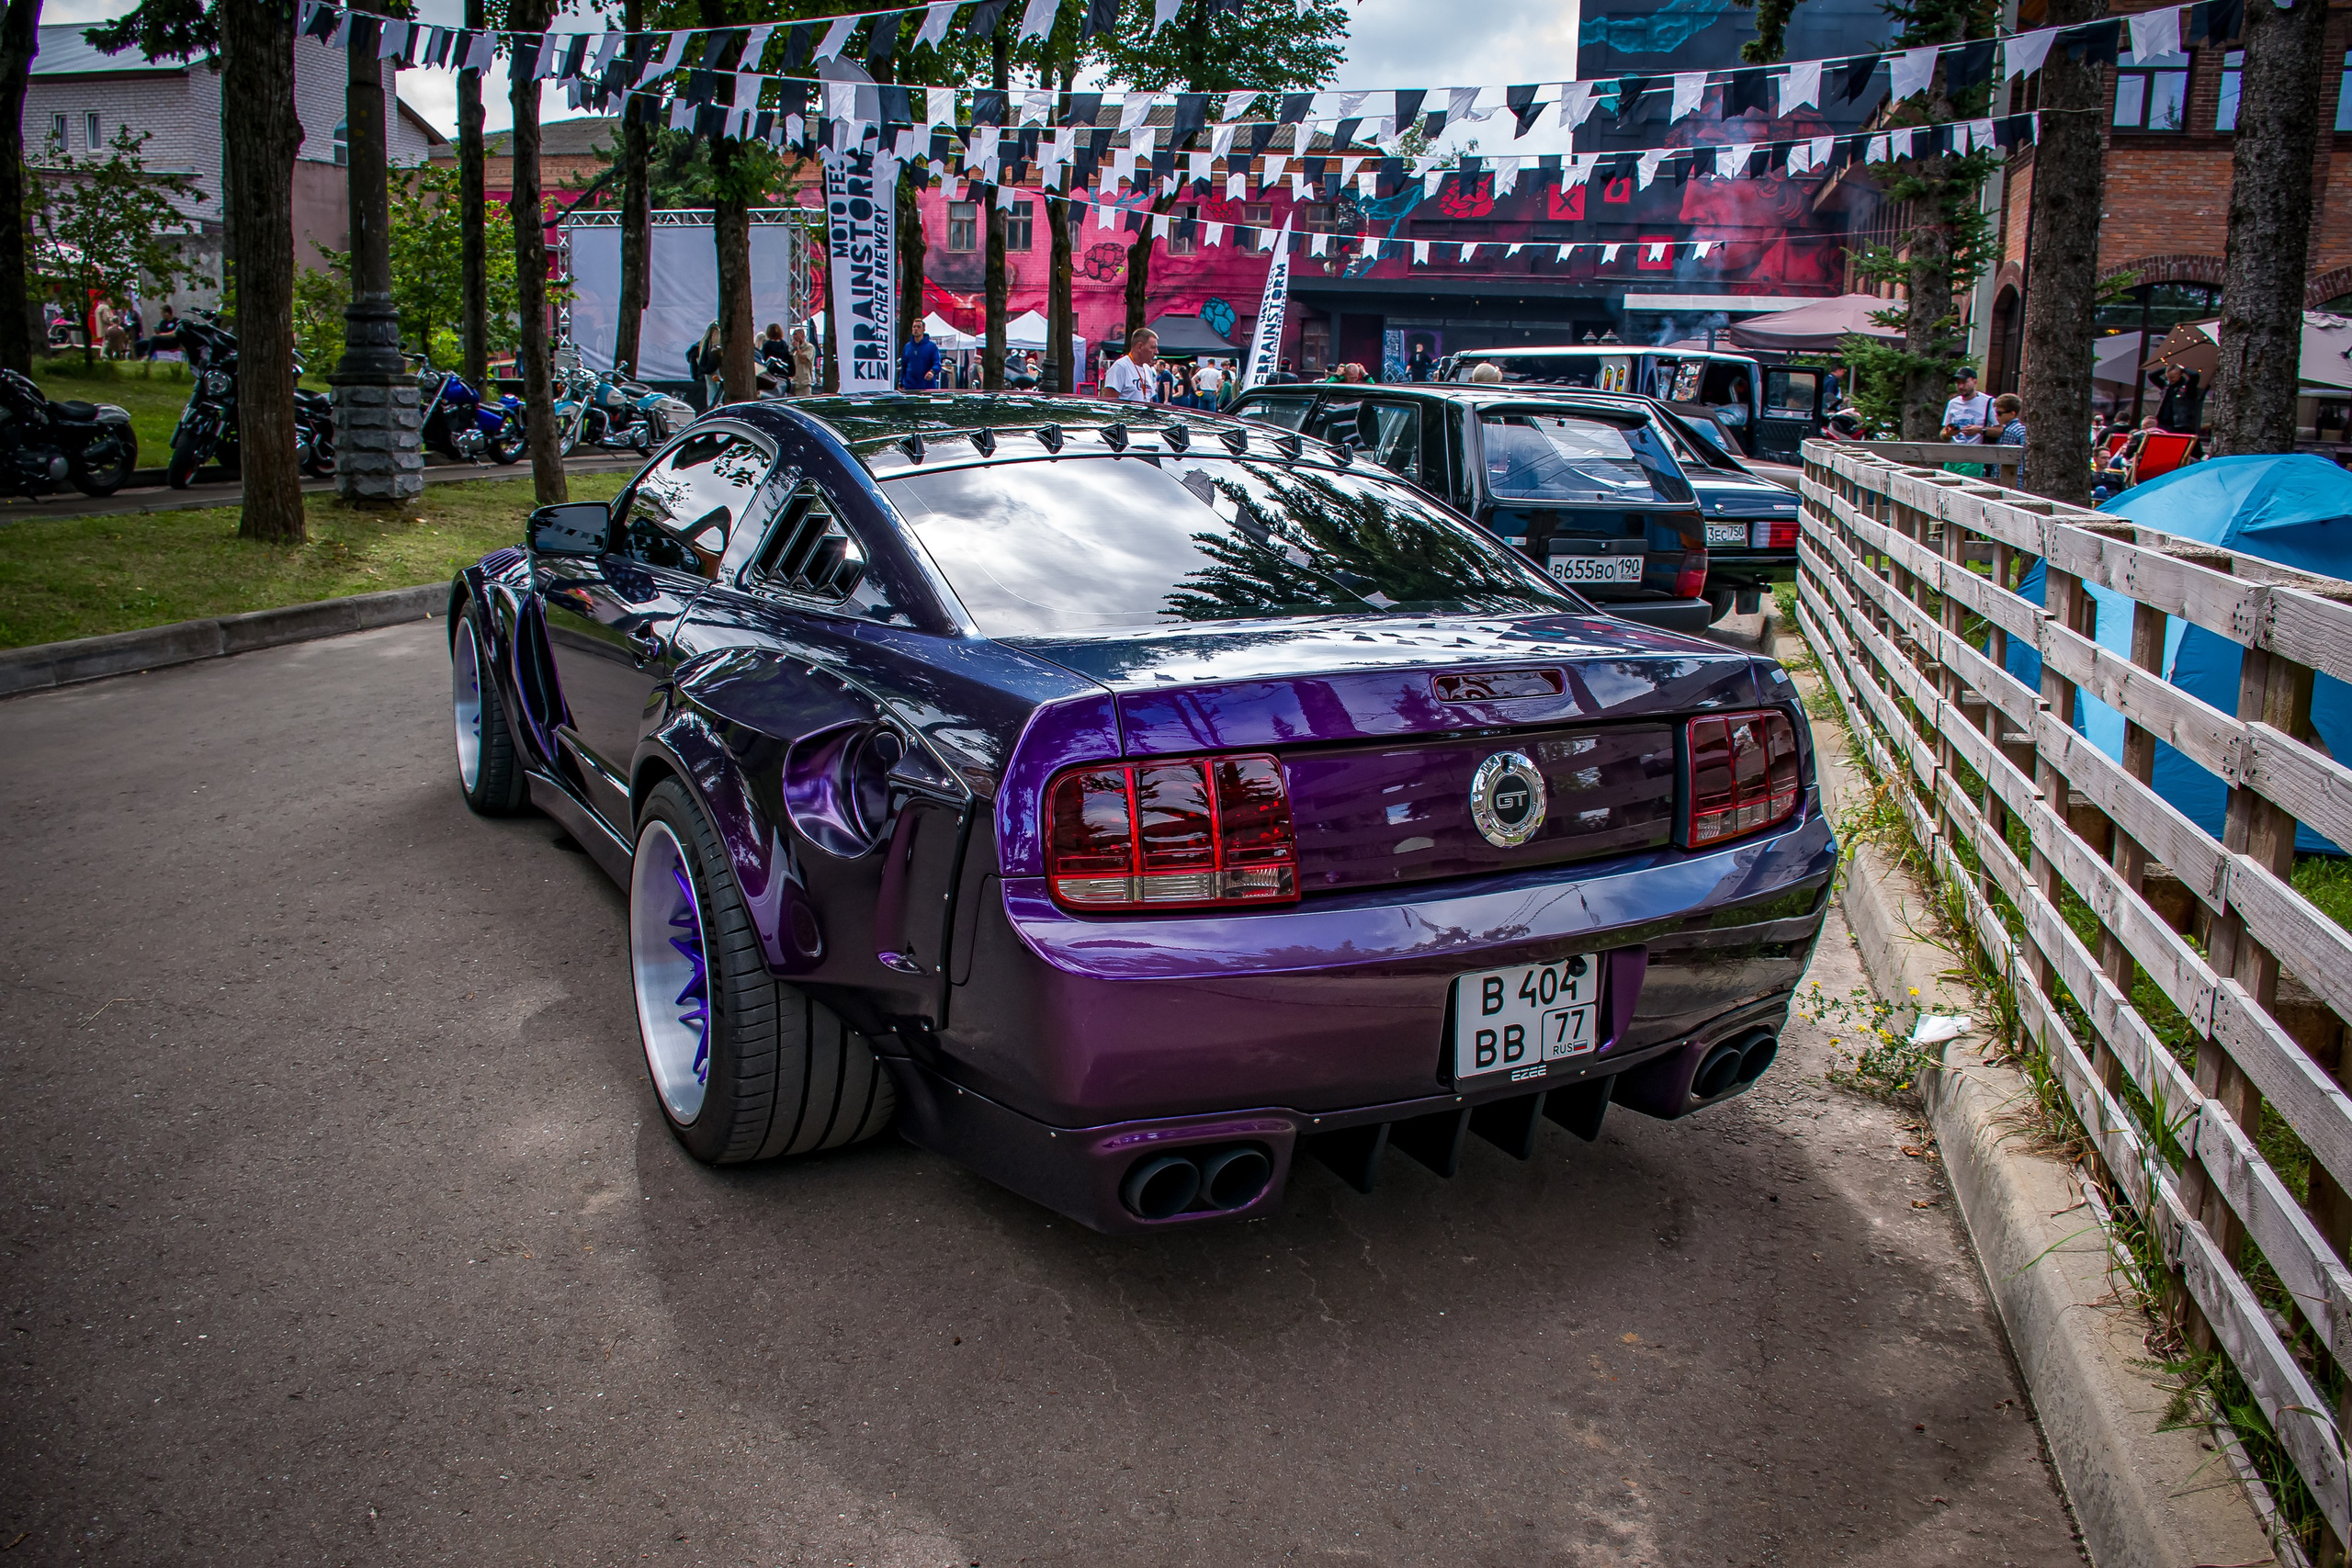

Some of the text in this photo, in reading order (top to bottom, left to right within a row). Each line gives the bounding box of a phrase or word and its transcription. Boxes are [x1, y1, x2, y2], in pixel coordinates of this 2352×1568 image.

[828, 152, 849, 258] MOTO FES
[875, 203, 888, 360] GLETCHER BREWERY
[1255, 263, 1286, 374] BRAINSTORM
[1728, 525, 1745, 537] 750
[1618, 558, 1640, 574] 190
[1496, 790, 1528, 809] GT
[1481, 966, 1577, 1017] B 404
[1555, 1009, 1585, 1043] 77
[1553, 1043, 1573, 1056] RUS
[1510, 1065, 1547, 1082] EZEE
